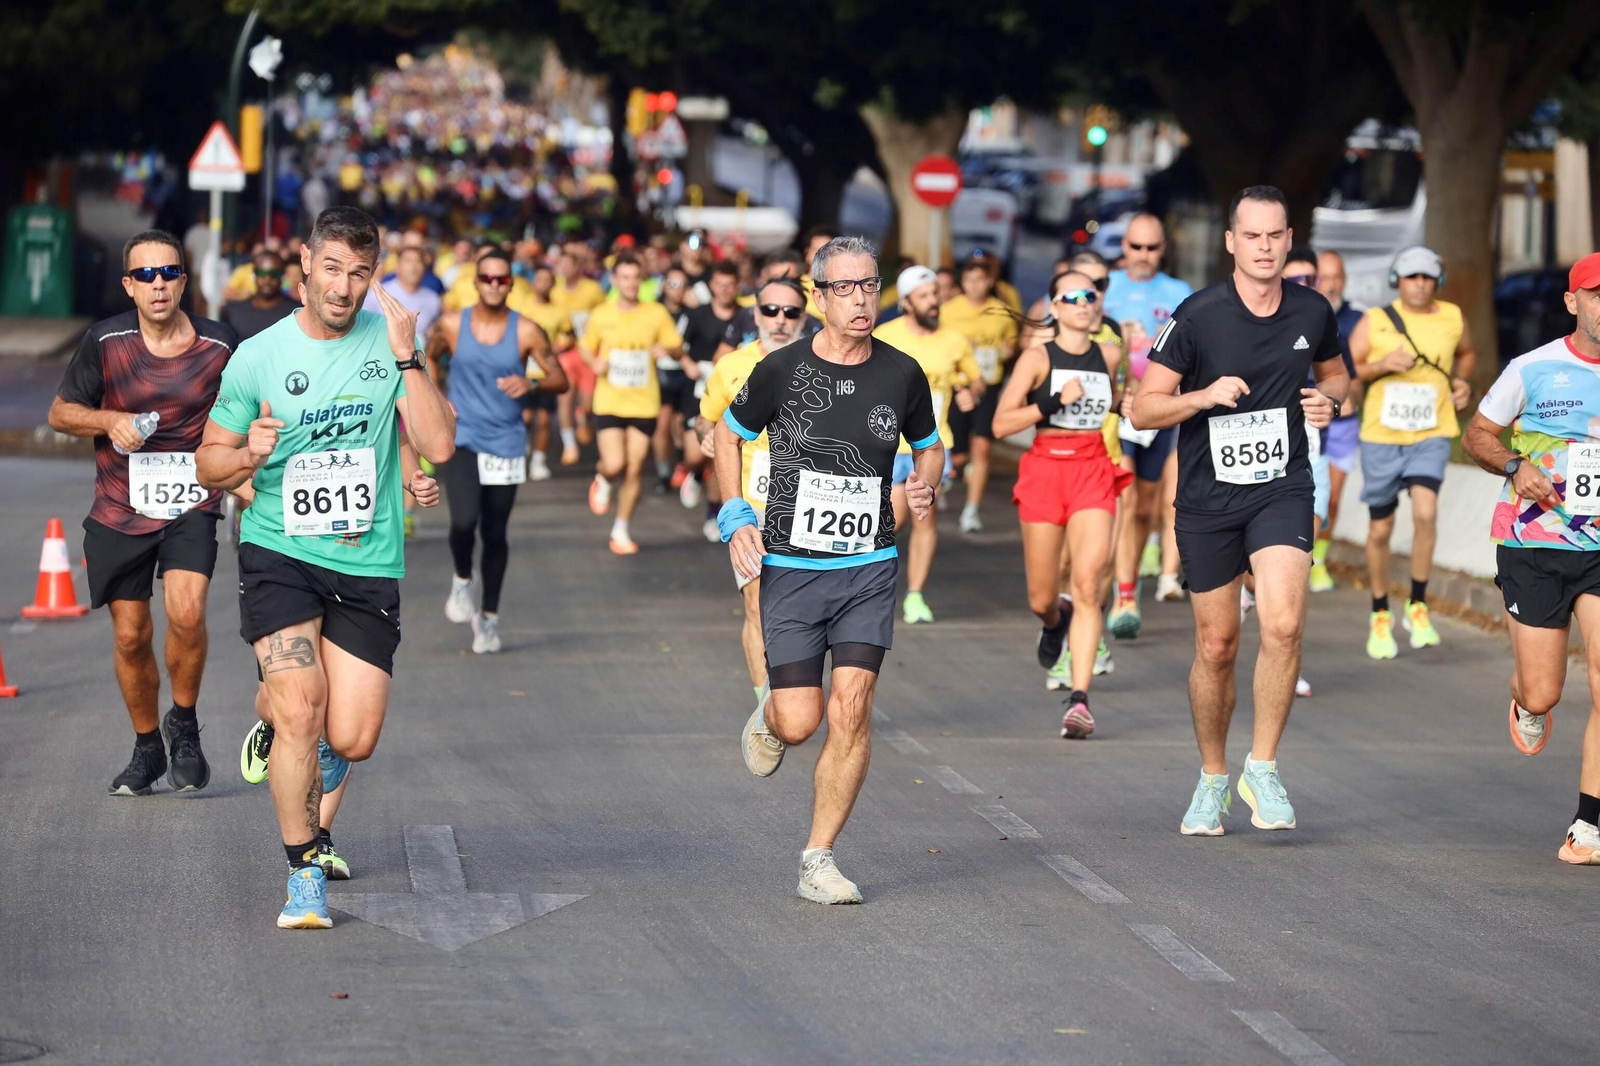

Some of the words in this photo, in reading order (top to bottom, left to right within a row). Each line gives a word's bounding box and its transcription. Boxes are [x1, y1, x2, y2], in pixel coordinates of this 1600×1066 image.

[299, 403, 374, 426] Islatrans
[1389, 402, 1433, 420] 5360
[1536, 400, 1583, 410] Málaga
[1538, 409, 1568, 419] 2025
[1220, 438, 1284, 468] 8584
[138, 483, 202, 505] 1525
[293, 483, 371, 516] 8613
[803, 507, 873, 538] 1260
